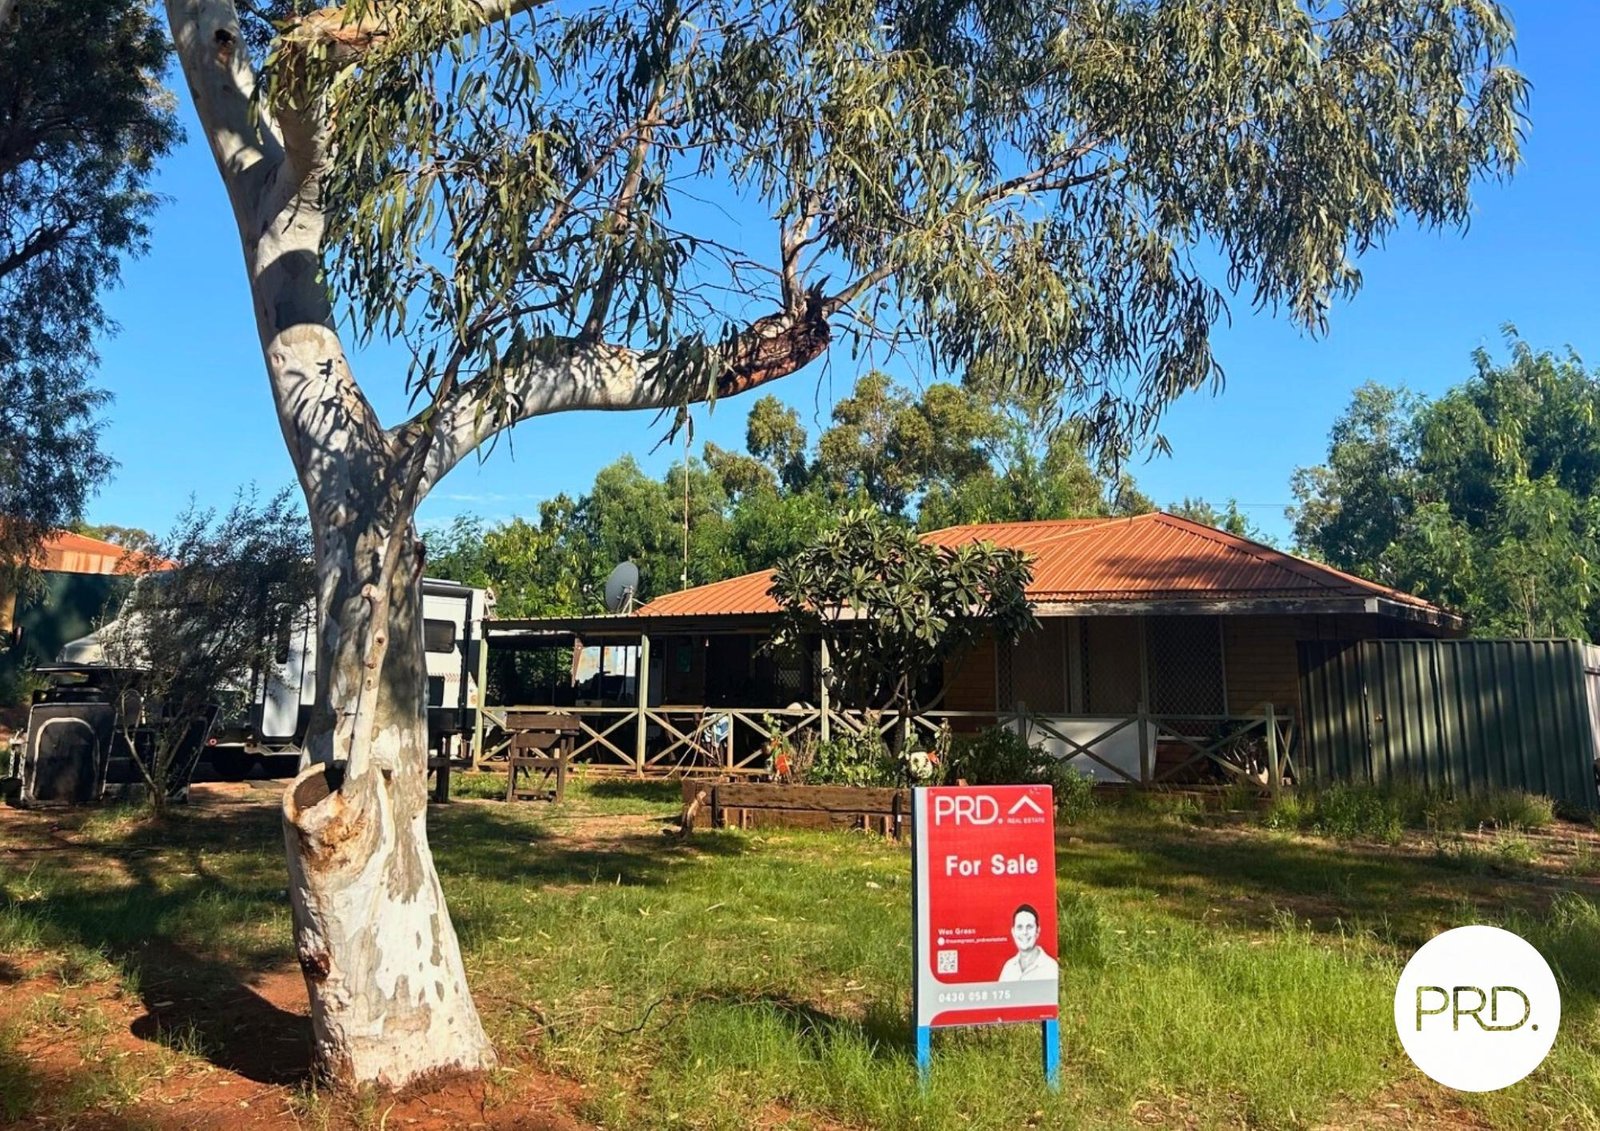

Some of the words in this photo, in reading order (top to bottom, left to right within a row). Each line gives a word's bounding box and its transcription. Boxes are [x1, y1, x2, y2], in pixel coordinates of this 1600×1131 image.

[935, 794, 1003, 826] PRD.
[946, 855, 981, 877] For
[991, 853, 1038, 875] Sale
[955, 927, 976, 935] Green
[938, 992, 965, 1003] 0430
[992, 989, 1011, 1000] 175
